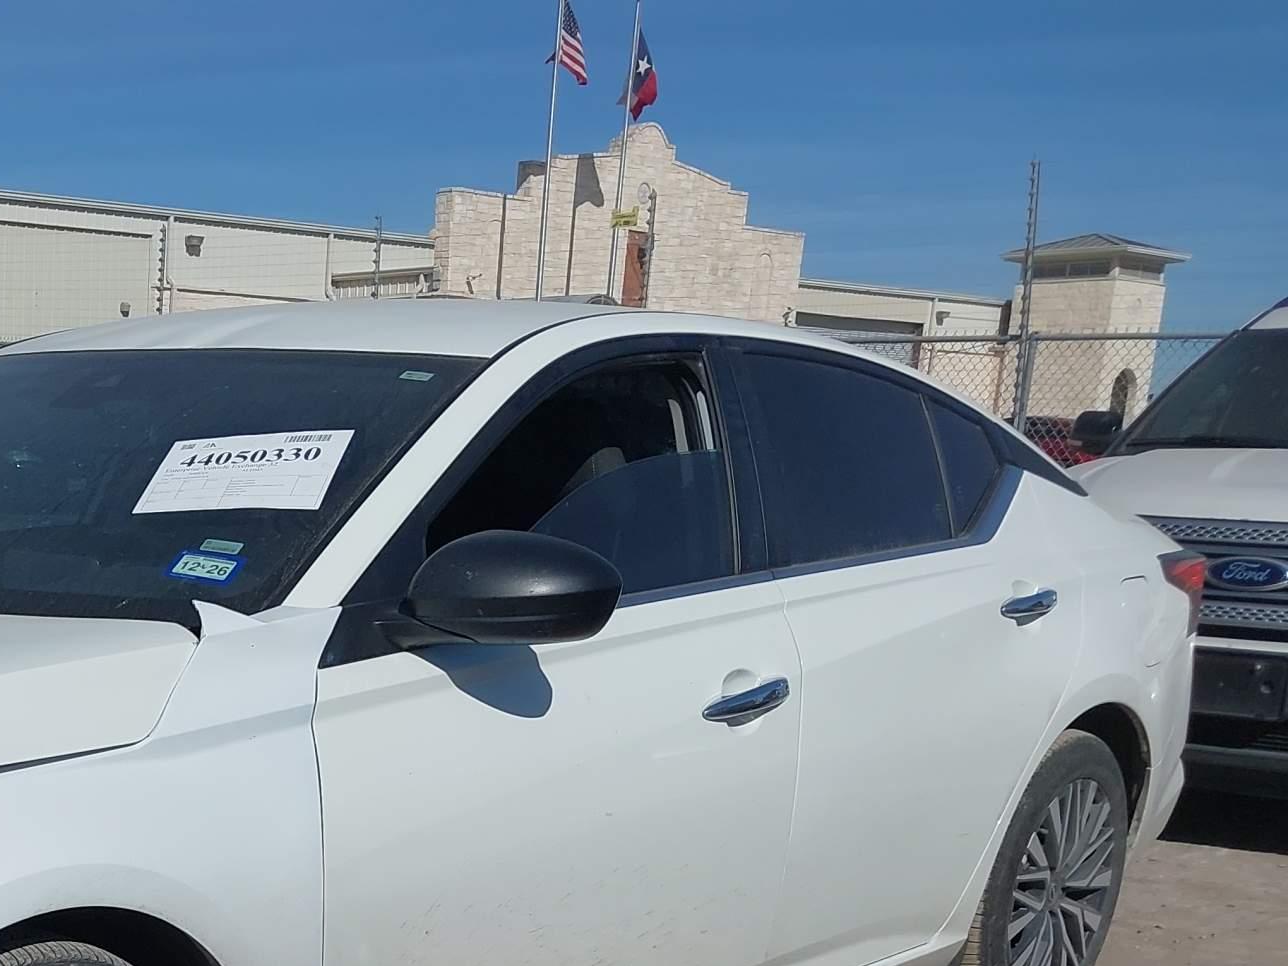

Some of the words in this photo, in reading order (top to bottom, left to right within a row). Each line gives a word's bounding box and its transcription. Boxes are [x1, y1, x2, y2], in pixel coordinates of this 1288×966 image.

[179, 446, 323, 468] 44050330
[180, 560, 201, 572] 12
[205, 564, 231, 577] 26
[1222, 561, 1272, 581] Ford
